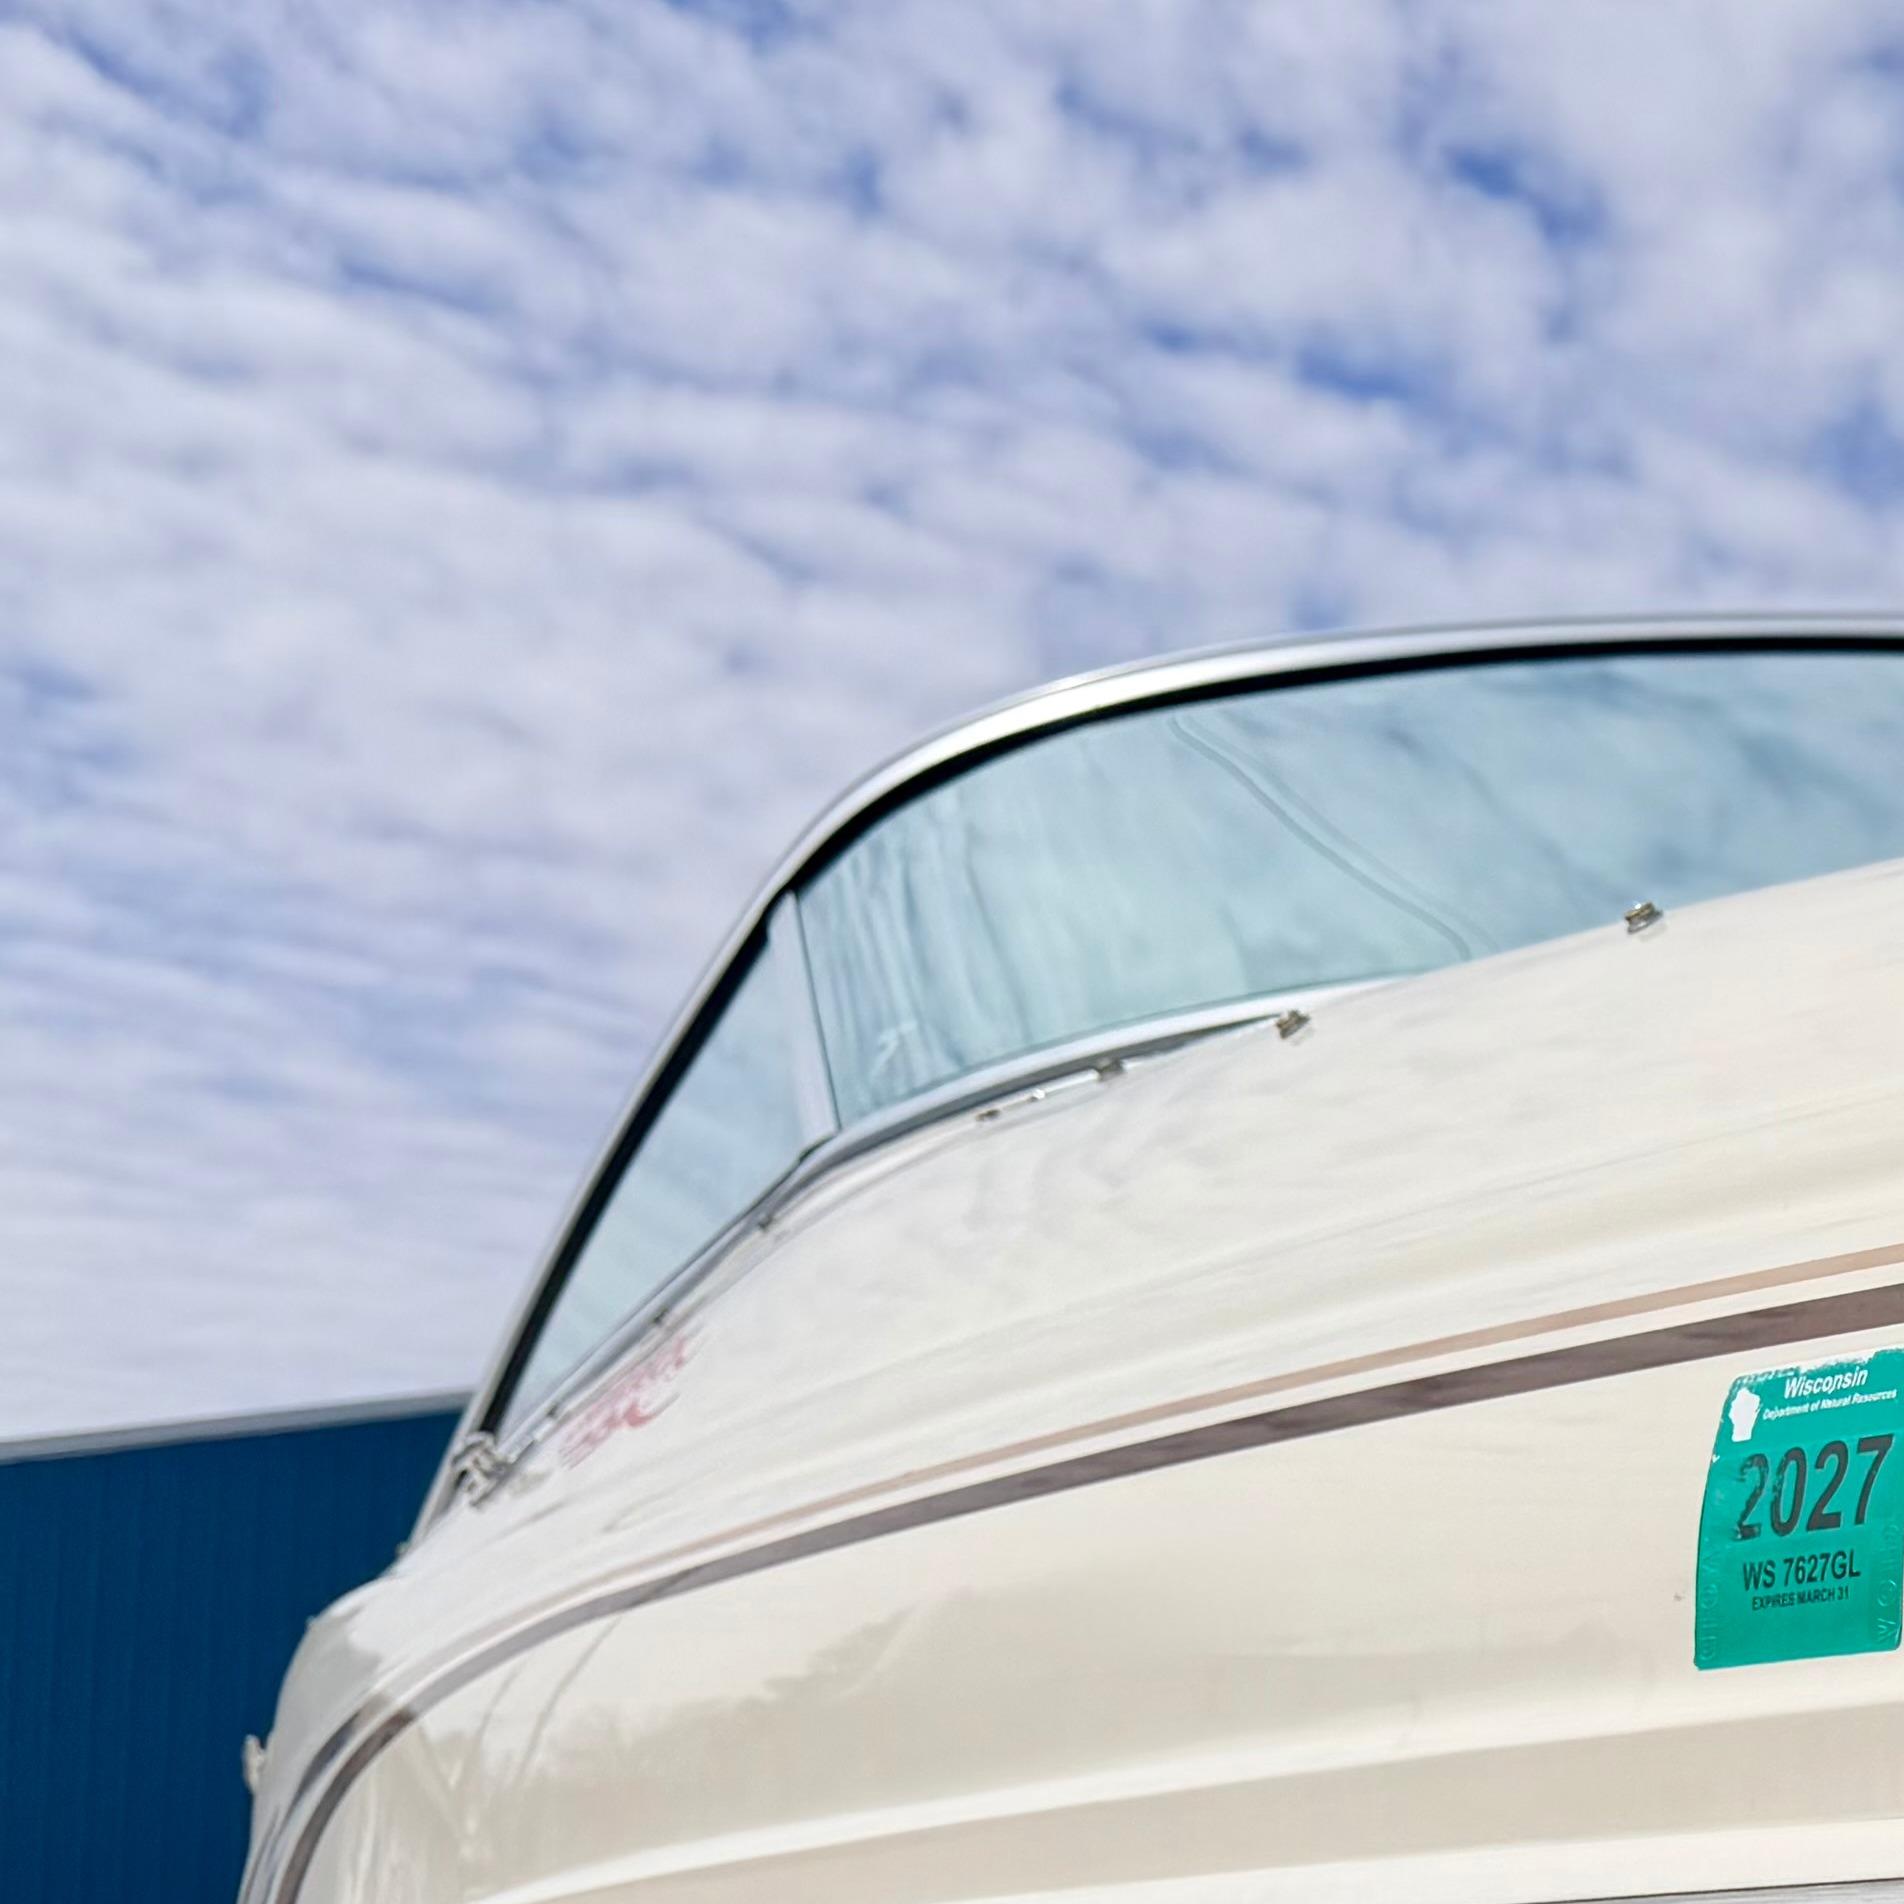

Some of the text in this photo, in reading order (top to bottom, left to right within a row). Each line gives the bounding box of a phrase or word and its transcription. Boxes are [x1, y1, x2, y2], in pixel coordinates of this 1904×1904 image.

[1784, 1366, 1868, 1399] Wisconsin
[1762, 1388, 1897, 1420] Department of Natural Resources
[1734, 1433, 1894, 1541] 2027
[1743, 1549, 1861, 1591] WS 7627GL
[1752, 1586, 1849, 1611] EXPIRES MARCH 31
